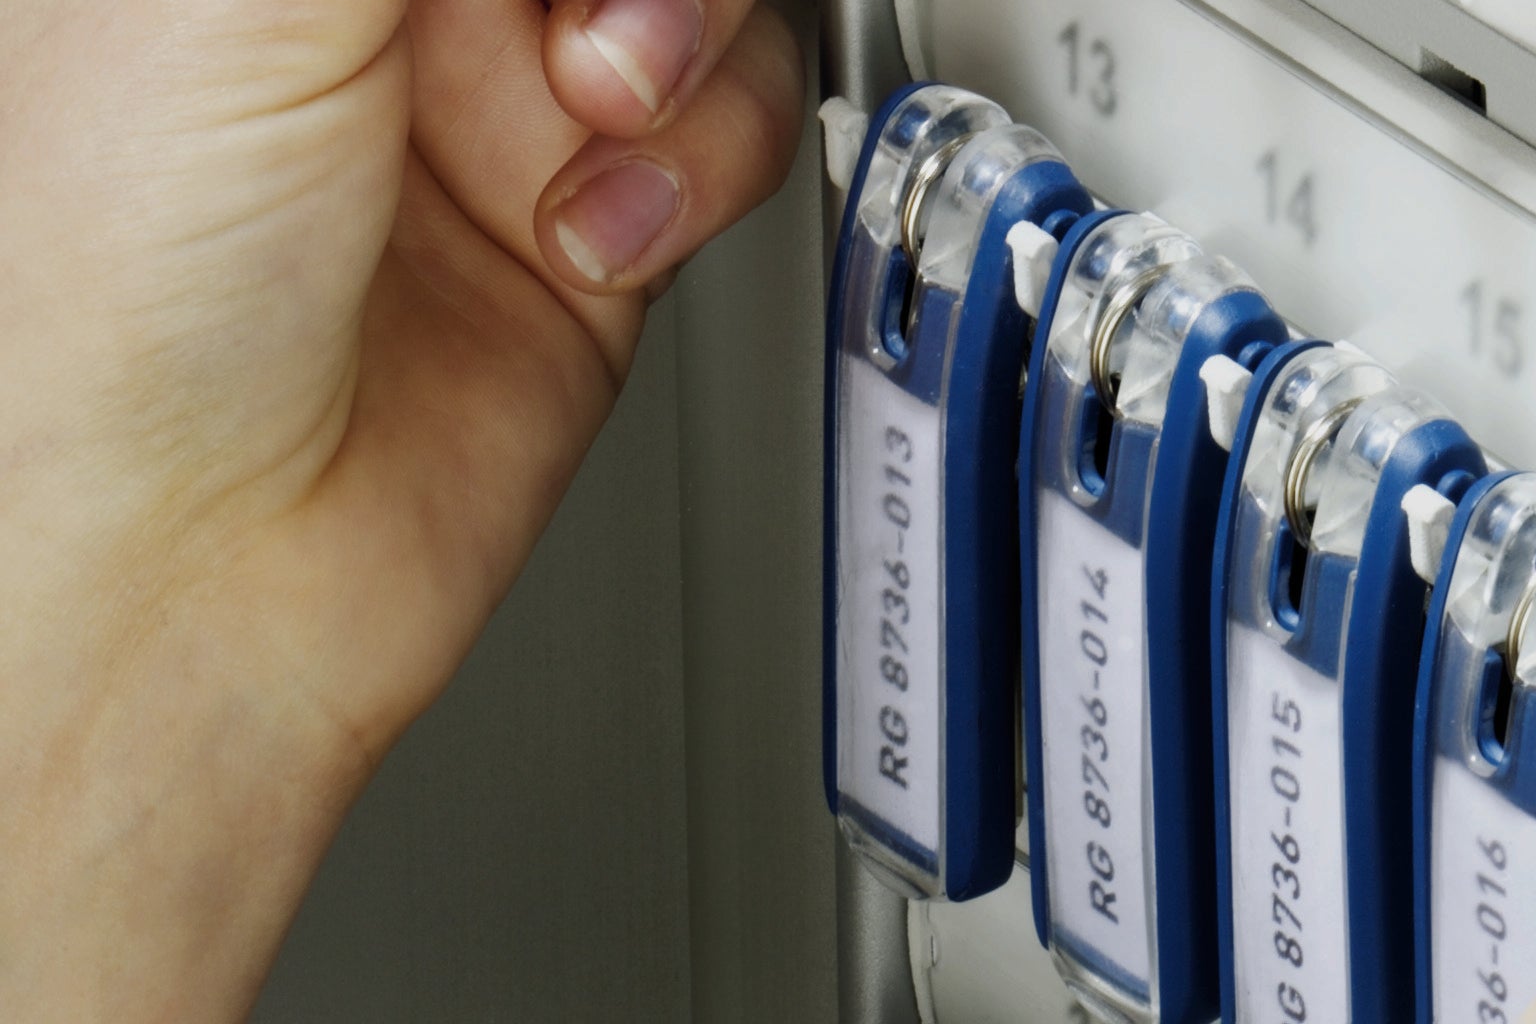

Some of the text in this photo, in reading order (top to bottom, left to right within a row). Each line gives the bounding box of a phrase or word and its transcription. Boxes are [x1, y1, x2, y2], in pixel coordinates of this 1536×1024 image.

[1055, 21, 1118, 118] 13
[1257, 153, 1318, 246] 14
[1463, 282, 1524, 378] 15
[879, 427, 912, 789] RG 8736-013
[1080, 565, 1118, 923] RG 8736-014
[1271, 698, 1306, 1024] G 8736-015
[1476, 836, 1507, 1024] 36-016
